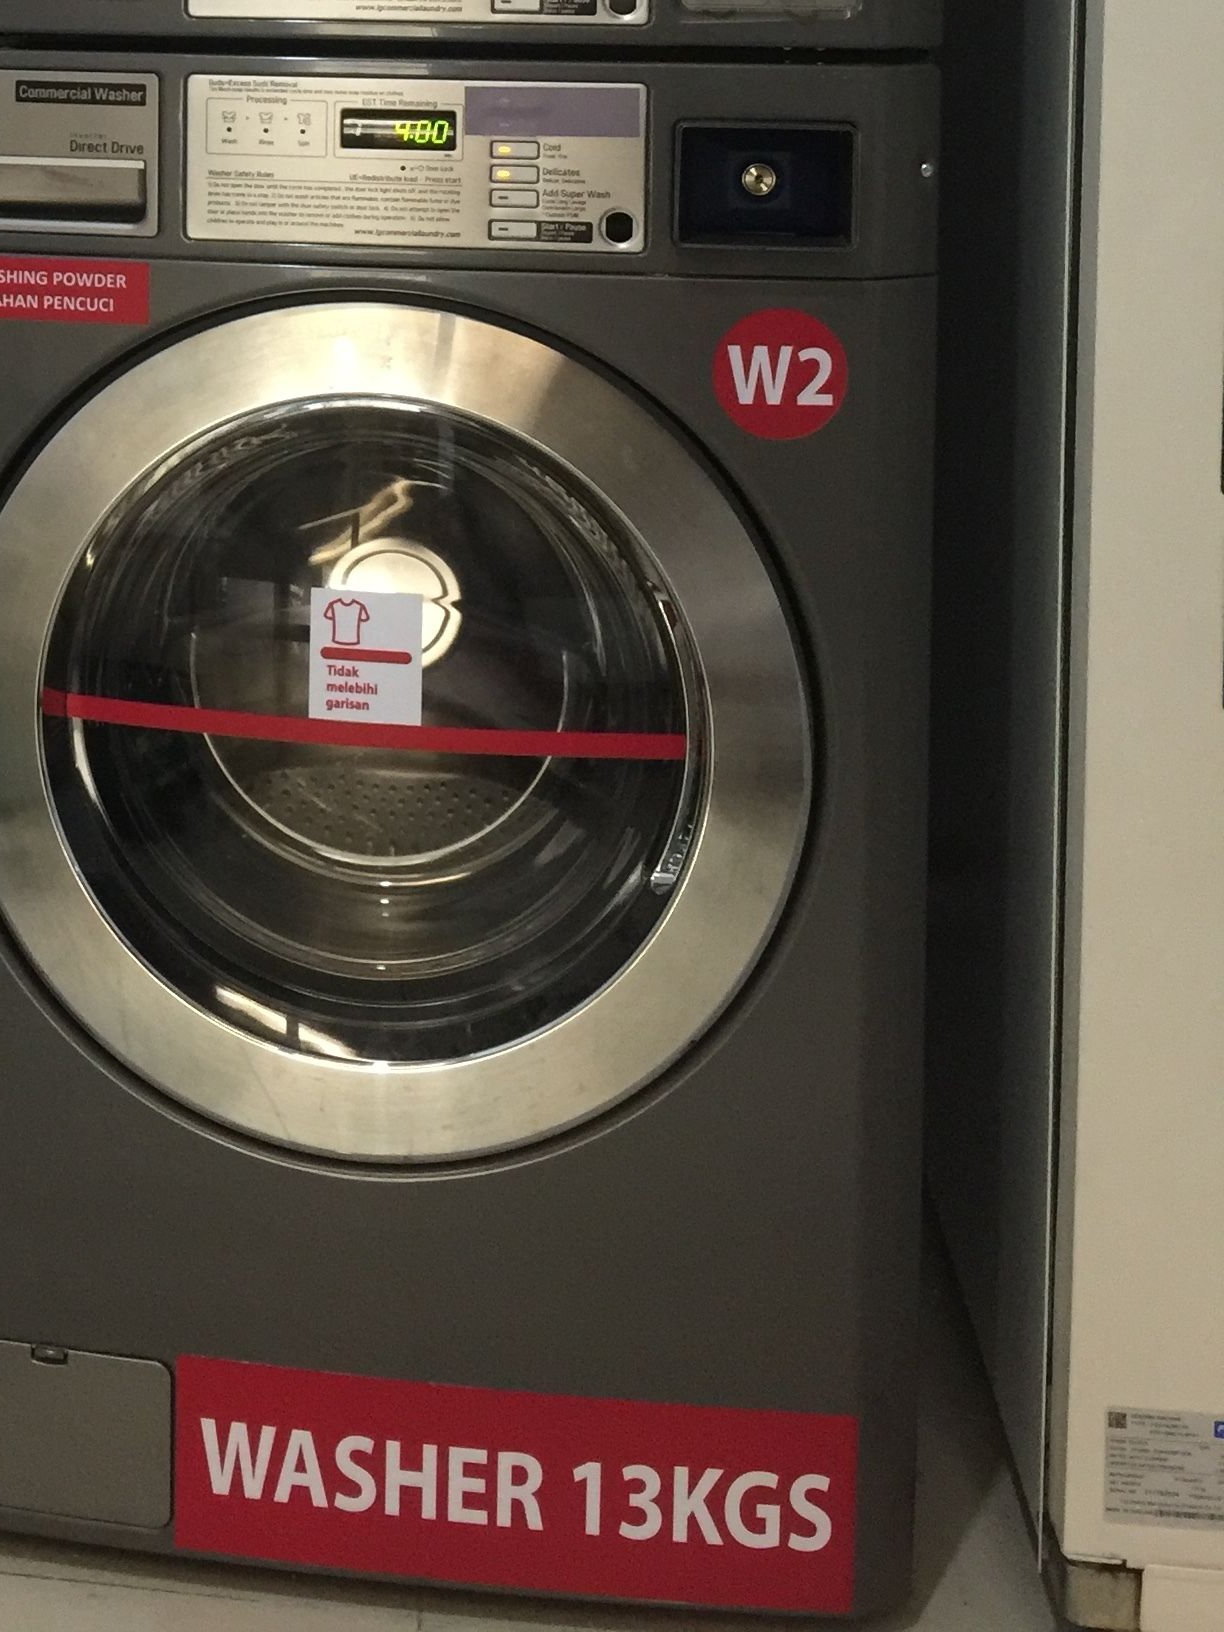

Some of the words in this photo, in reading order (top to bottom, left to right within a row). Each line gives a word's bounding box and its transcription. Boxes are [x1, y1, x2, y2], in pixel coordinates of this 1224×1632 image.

[19, 85, 91, 100] Commercial
[94, 87, 143, 102] Washer
[247, 96, 287, 105] Processing
[70, 139, 107, 153] Direct
[112, 141, 144, 155] Drive
[53, 271, 127, 288] POWDER
[43, 295, 114, 312] PENCUCI
[727, 345, 834, 405] W2
[327, 665, 359, 678] Tidak
[326, 682, 378, 695] melebihi
[326, 698, 370, 711] garisan
[200, 1417, 545, 1532] WASHER
[572, 1463, 833, 1554] 13KGS
